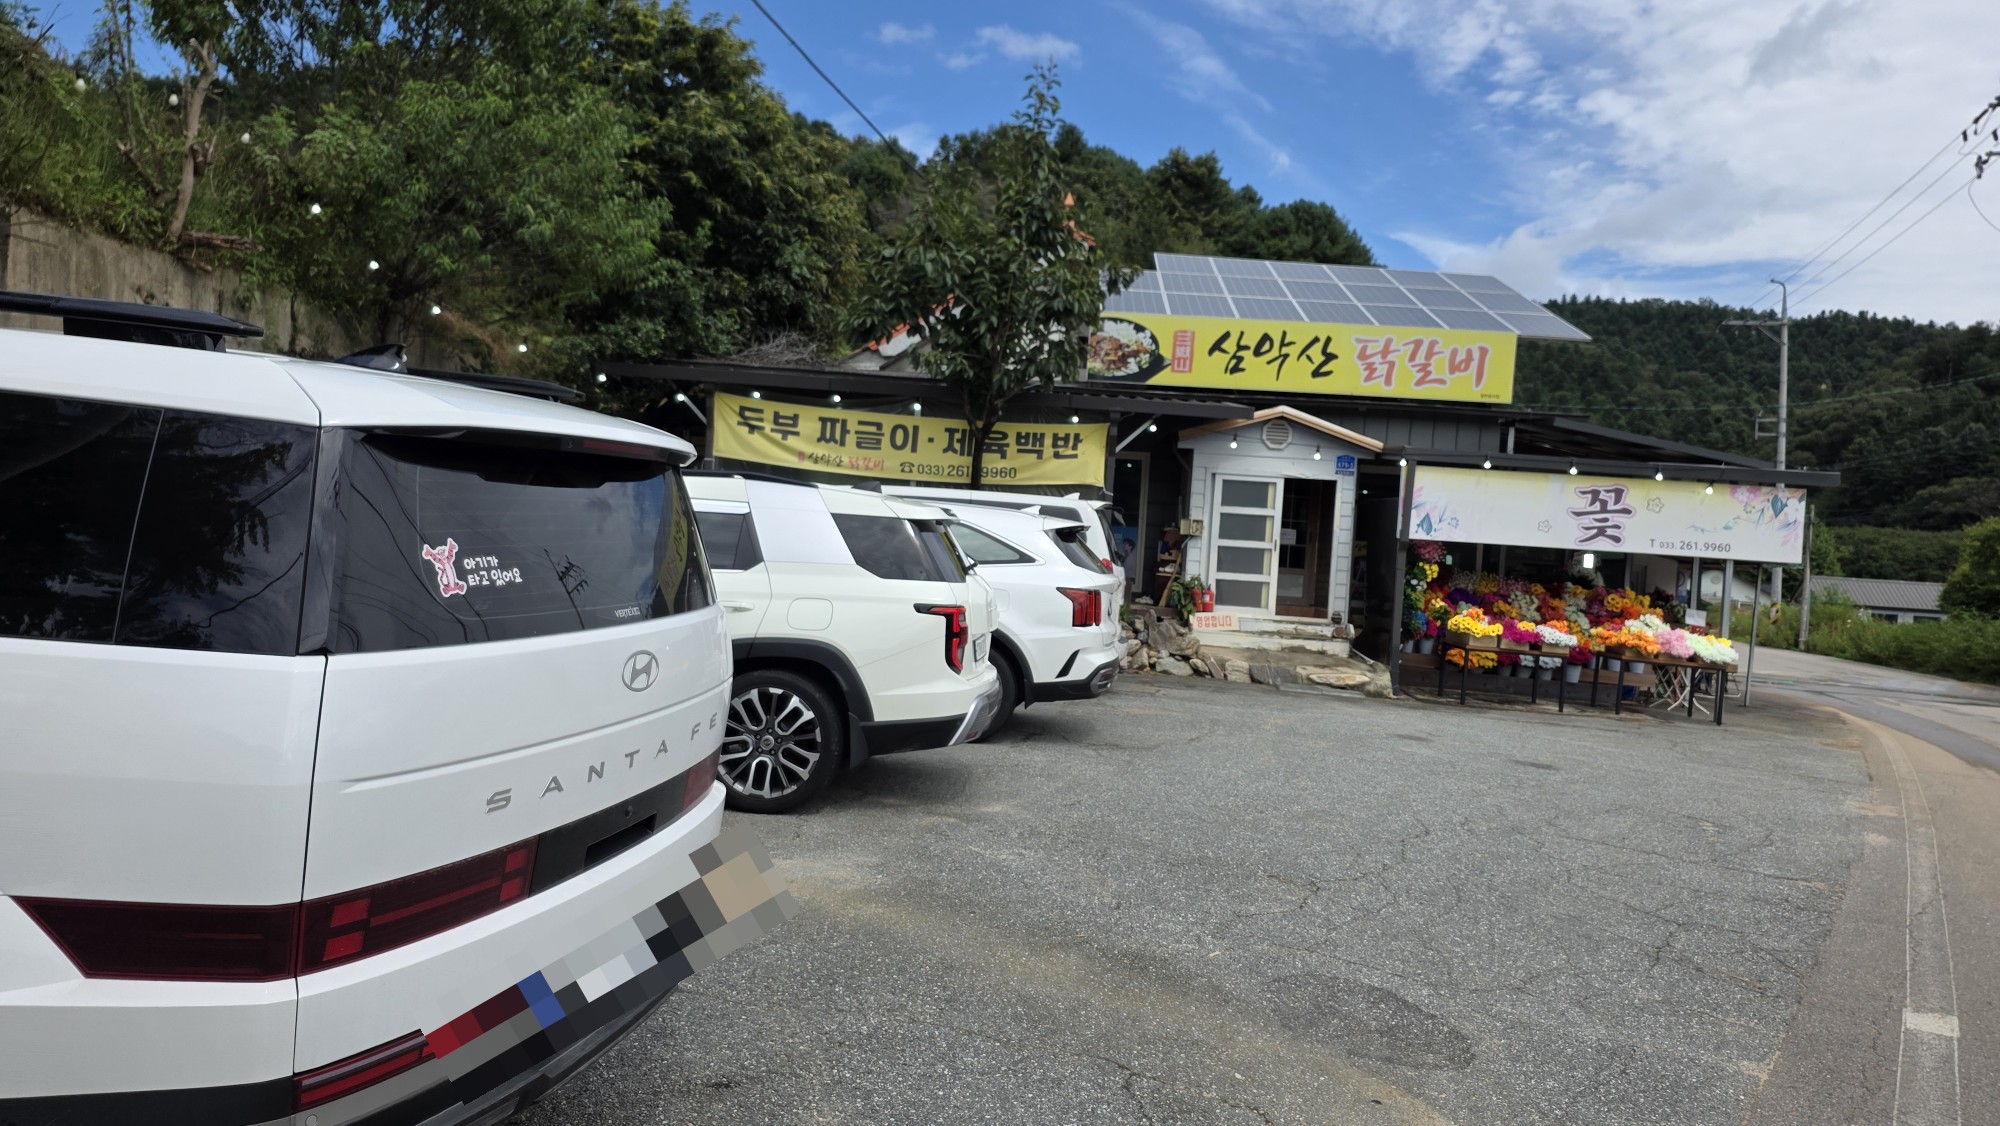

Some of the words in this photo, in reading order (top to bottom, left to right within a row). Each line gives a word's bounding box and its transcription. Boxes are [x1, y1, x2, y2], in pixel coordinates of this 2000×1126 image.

[1208, 330, 1339, 382] 삼악산
[1353, 336, 1489, 389] 닭갈비
[737, 405, 800, 441] 두부
[1569, 485, 1634, 545] 꽃
[1649, 538, 1655, 548] T
[463, 555, 498, 569] 아기가
[467, 570, 490, 586] 타고
[490, 567, 523, 586] 있어요
[1196, 615, 1232, 628] 영업합니다
[485, 739, 668, 814] SANTA
[690, 712, 719, 742] FE
